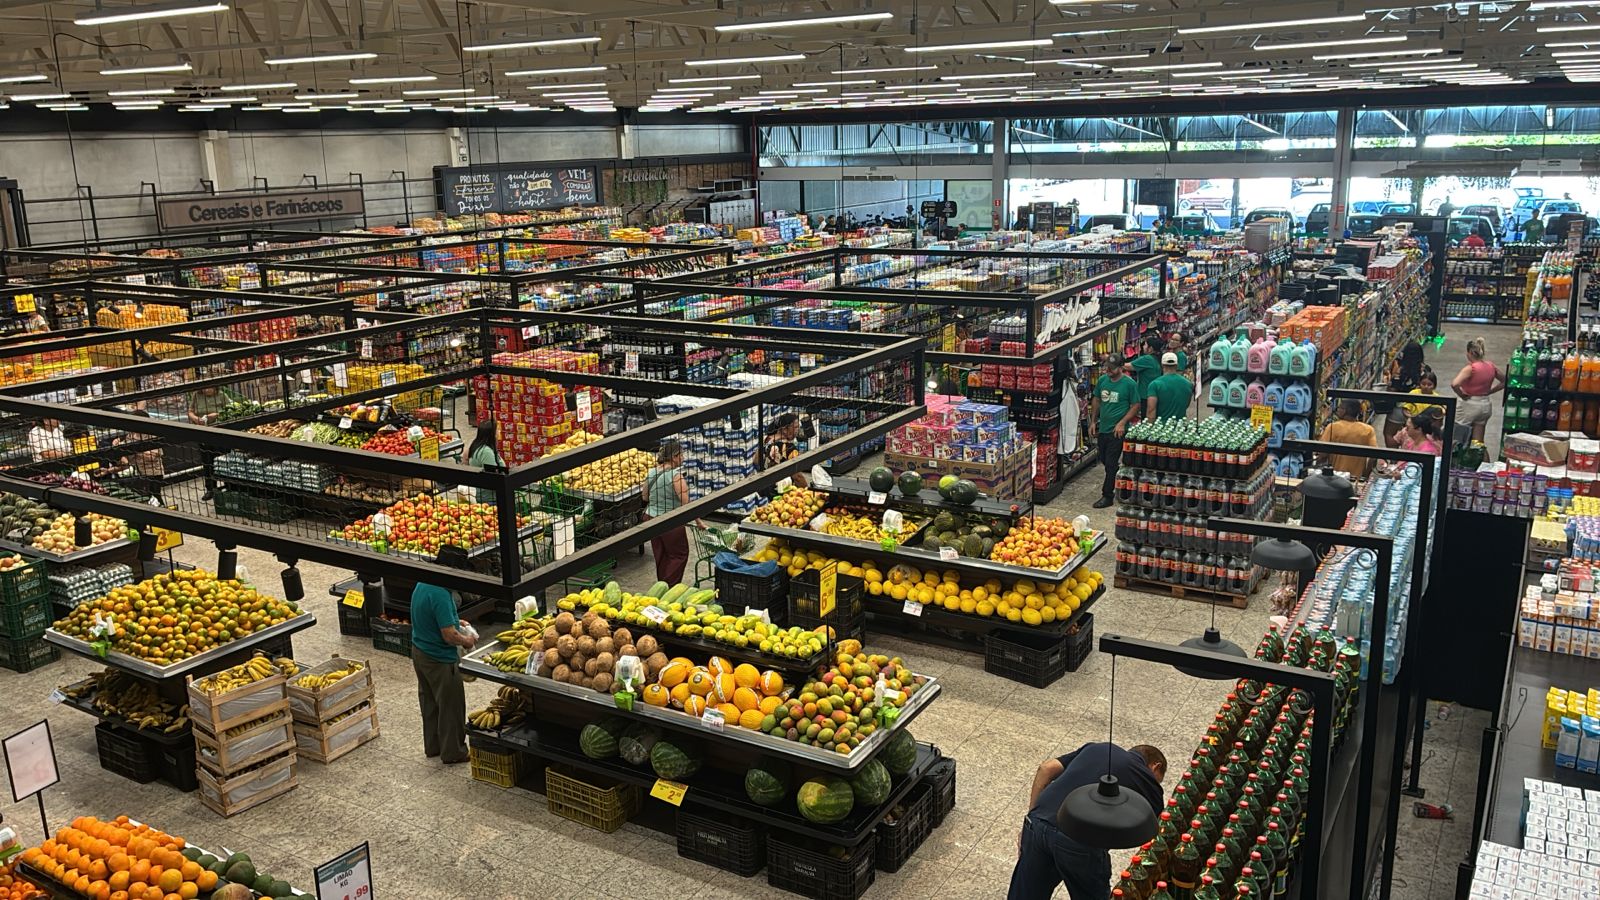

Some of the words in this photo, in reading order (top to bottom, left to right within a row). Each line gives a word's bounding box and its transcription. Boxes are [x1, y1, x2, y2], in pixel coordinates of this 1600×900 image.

[504, 170, 552, 184] qualidade
[568, 169, 587, 180] VEM
[566, 182, 591, 190] COMPRAR
[566, 189, 592, 202] bem
[188, 202, 249, 222] Cereais
[253, 204, 263, 217] e
[266, 197, 343, 216] Farináceos
[333, 869, 353, 884] LIMAO
[340, 880, 348, 888] KG
